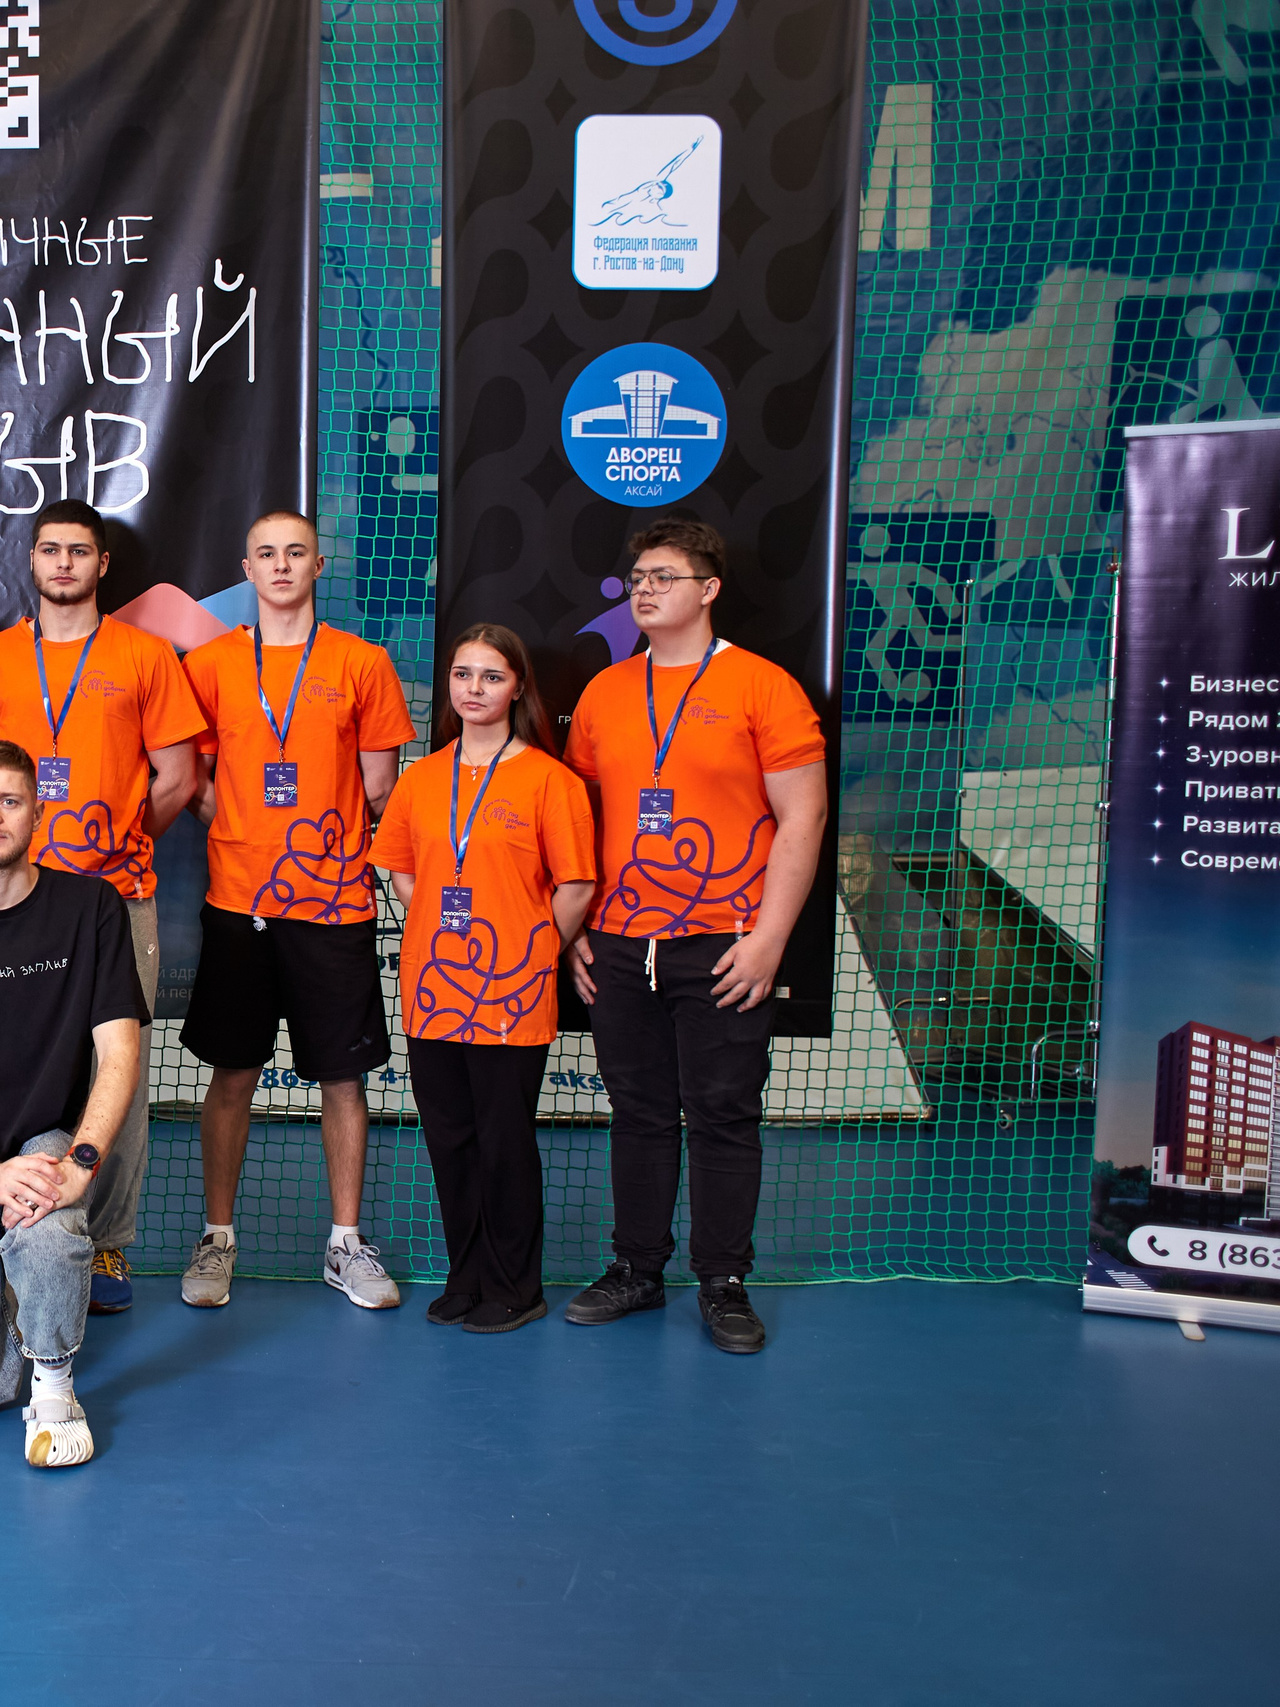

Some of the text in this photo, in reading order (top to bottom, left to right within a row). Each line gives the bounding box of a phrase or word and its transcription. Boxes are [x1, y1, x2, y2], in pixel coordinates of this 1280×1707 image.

[593, 235, 698, 254] Федерация плавания
[593, 255, 685, 274] г. Ростов-на-Дону
[605, 447, 682, 466] ДВОРЕЦ
[604, 465, 681, 482] СПОРТА
[624, 483, 663, 496] АКСАЙ
[1190, 675, 1280, 693] Бизнес
[1188, 710, 1268, 731] Рядом
[1188, 1239, 1207, 1261] 8
